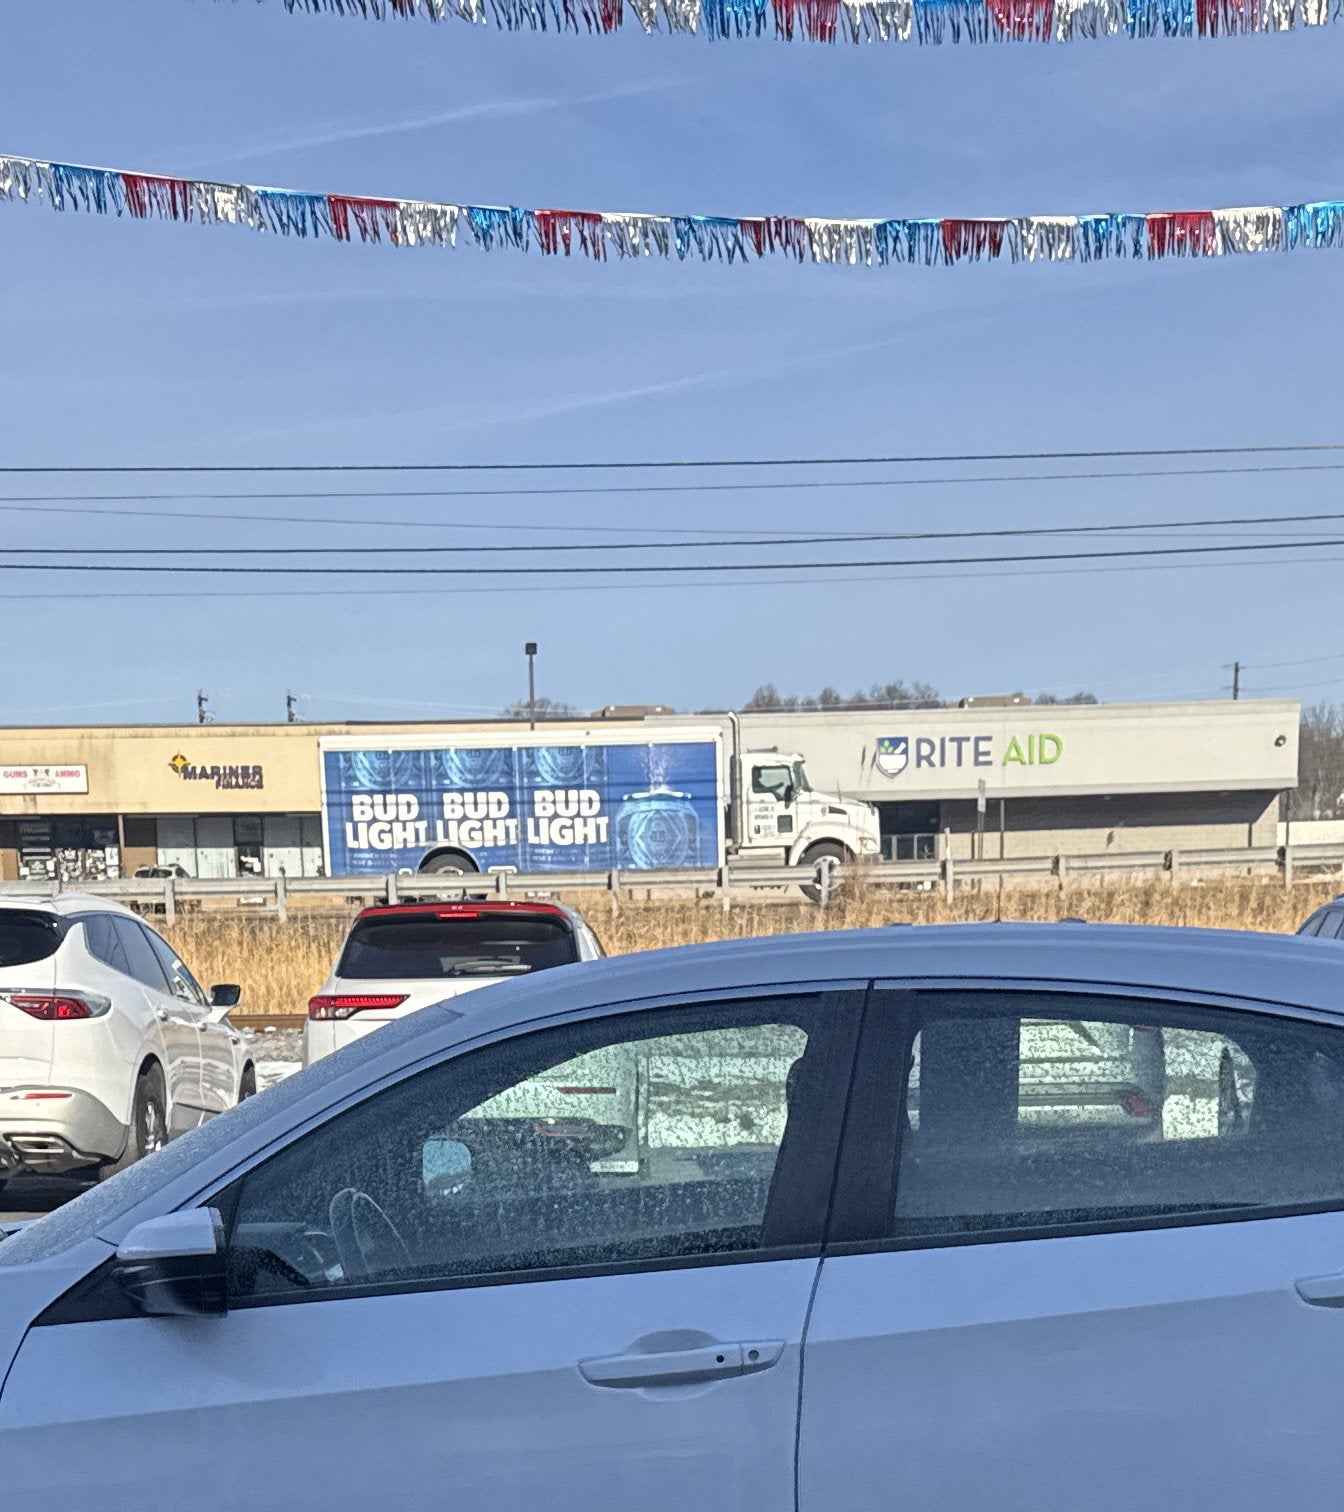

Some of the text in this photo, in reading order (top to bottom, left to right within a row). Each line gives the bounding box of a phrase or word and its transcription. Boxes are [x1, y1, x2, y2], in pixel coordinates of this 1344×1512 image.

[915, 733, 1063, 768] RITE AID
[183, 765, 263, 781] MARINER
[352, 794, 419, 821] BUD
[442, 791, 510, 820] BUD
[534, 790, 601, 817] BUD
[346, 820, 428, 849] LIGHT
[436, 819, 518, 849] LIGHT
[527, 816, 609, 846] LIGHT
